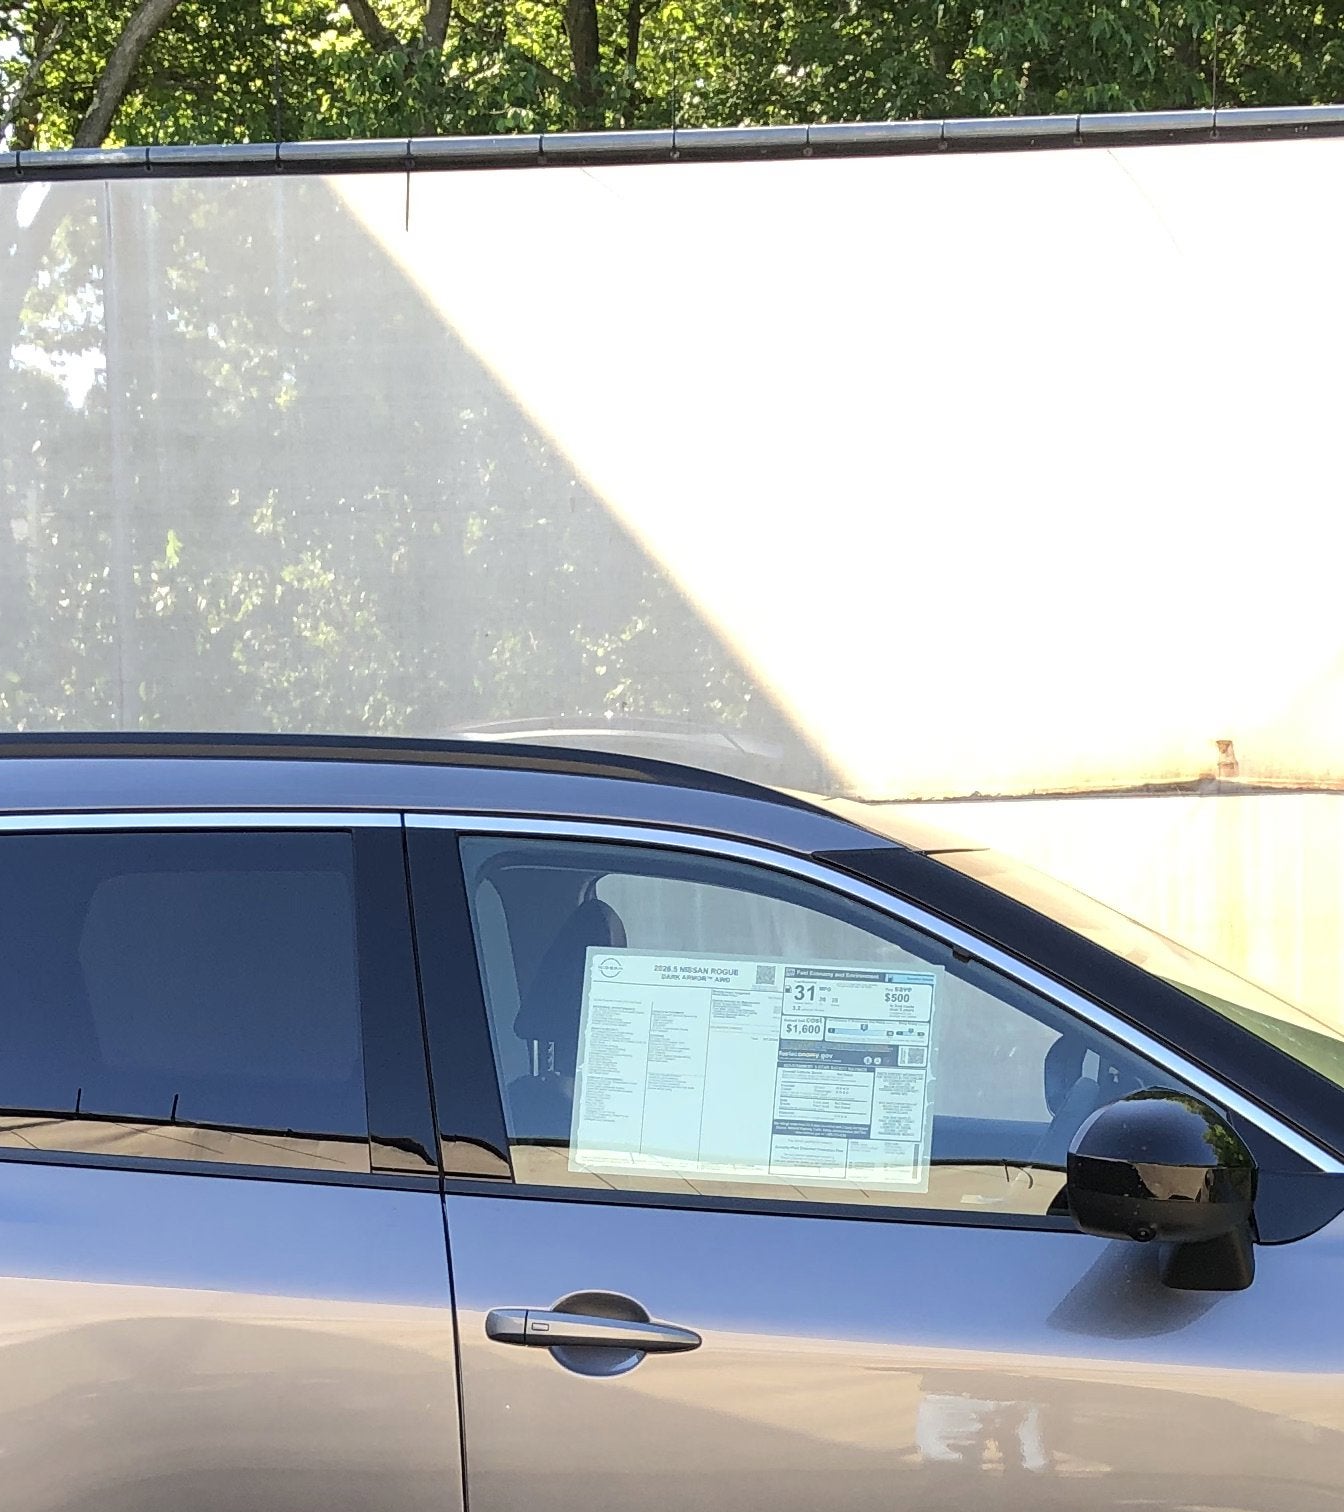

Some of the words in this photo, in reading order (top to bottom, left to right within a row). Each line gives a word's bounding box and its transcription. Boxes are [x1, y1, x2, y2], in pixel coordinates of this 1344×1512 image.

[661, 973, 681, 981] DARK
[679, 966, 709, 975] NISSAN
[710, 968, 739, 977] ROGUE
[794, 984, 815, 1001] 31
[884, 992, 910, 1003] $500
[786, 1023, 821, 1035] $1,600
